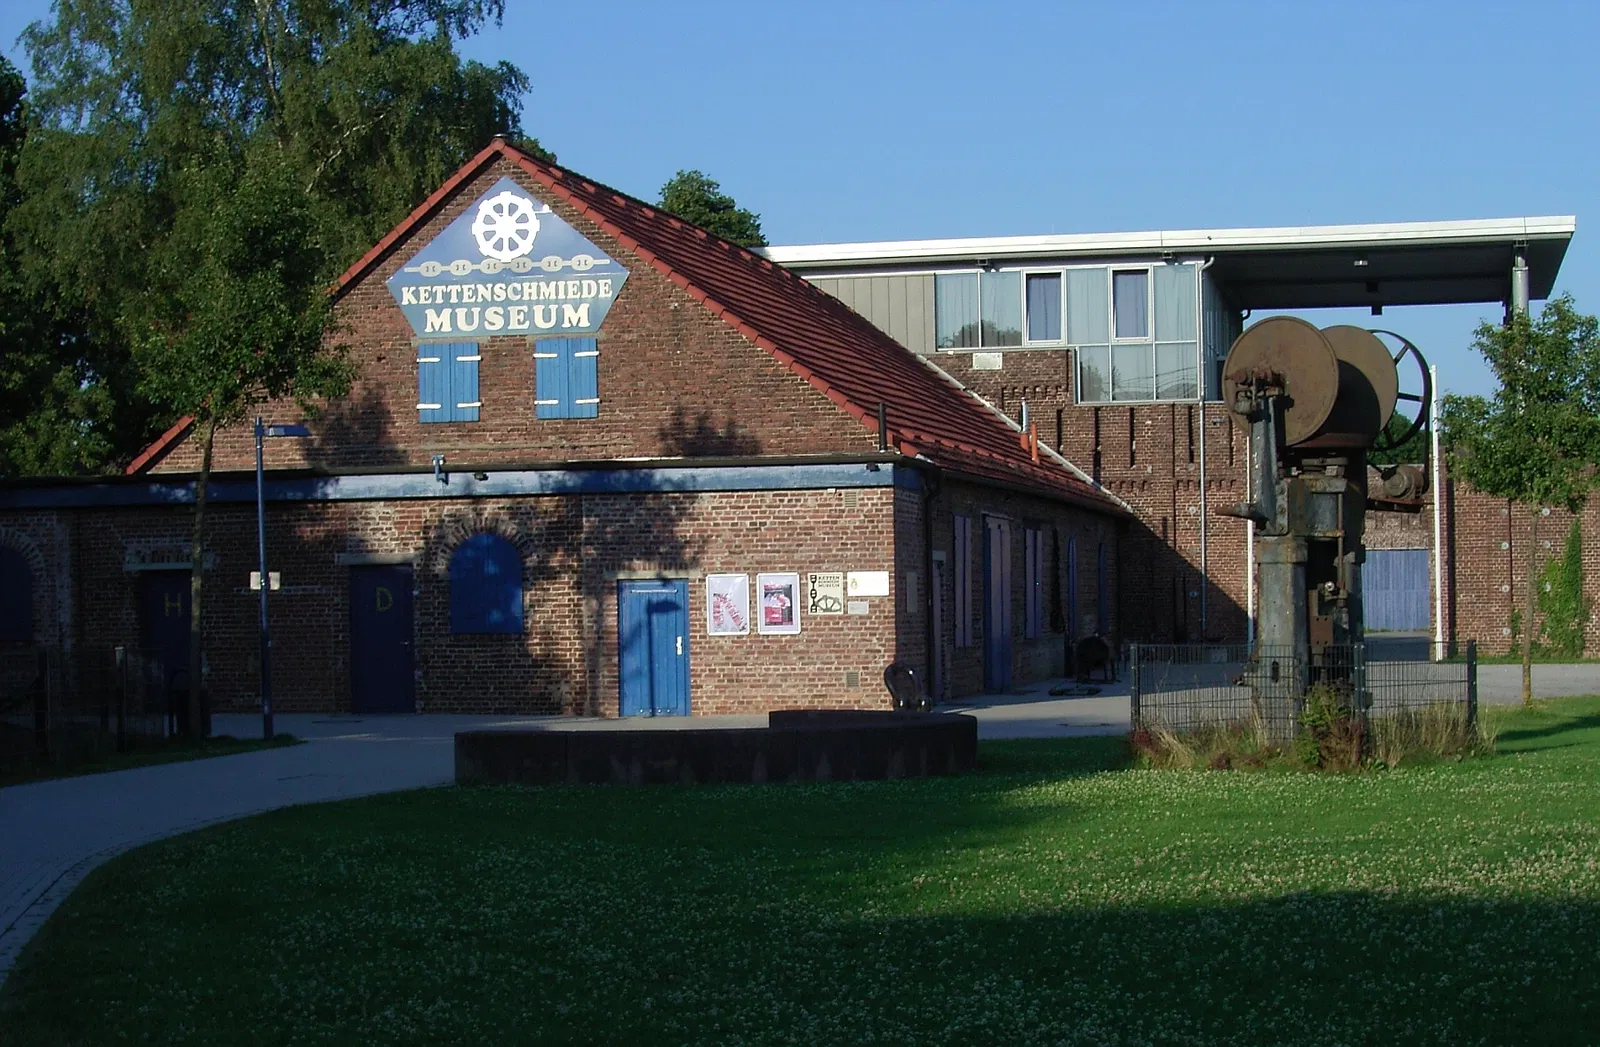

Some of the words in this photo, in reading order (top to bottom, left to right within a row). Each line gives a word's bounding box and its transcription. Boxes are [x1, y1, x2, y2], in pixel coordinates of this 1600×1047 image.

[401, 279, 612, 305] KETTENSCHMIEDE
[424, 303, 590, 332] MUSEUM
[164, 593, 182, 617] H
[375, 587, 393, 613] D
